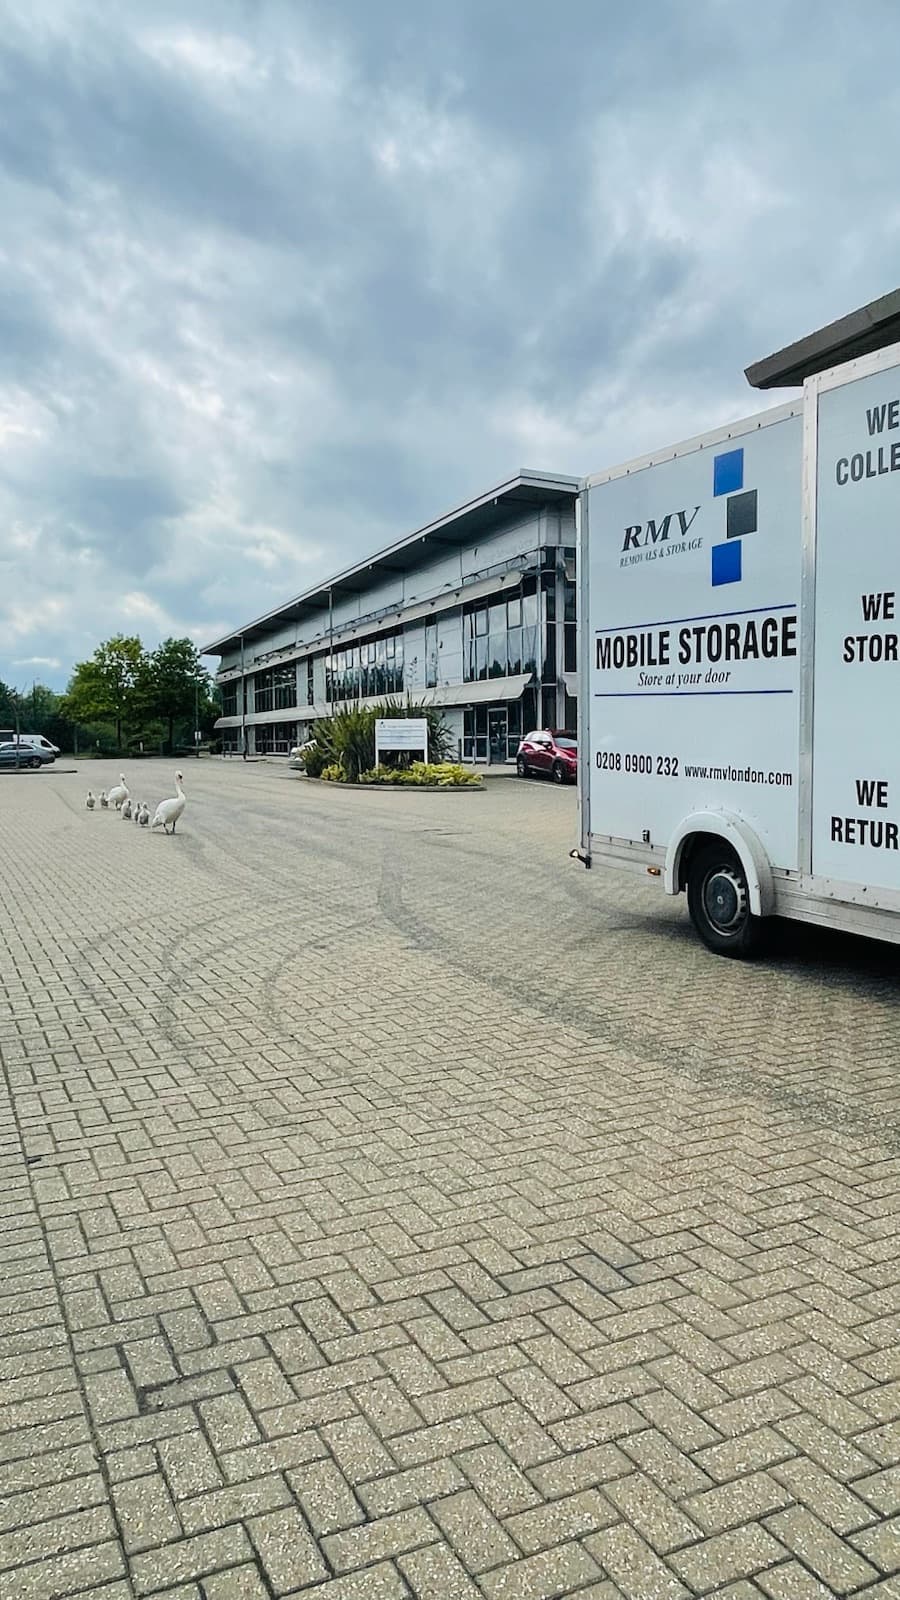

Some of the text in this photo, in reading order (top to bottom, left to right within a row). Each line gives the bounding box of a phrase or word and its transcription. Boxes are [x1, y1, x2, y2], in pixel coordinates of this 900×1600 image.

[866, 400, 900, 436] WE
[836, 442, 900, 485] COLLE
[621, 505, 701, 552] RMV
[619, 537, 703, 568] REMOVALS & STORAGE
[861, 592, 895, 621] WE
[596, 616, 798, 670] MOBILE STORAGE
[843, 634, 898, 663] STOR
[638, 668, 731, 688] Store at your door
[596, 751, 793, 786] 0208 0900 232 www.rmvlondon.com
[855, 780, 888, 808] WE
[831, 816, 899, 850] RETUR
